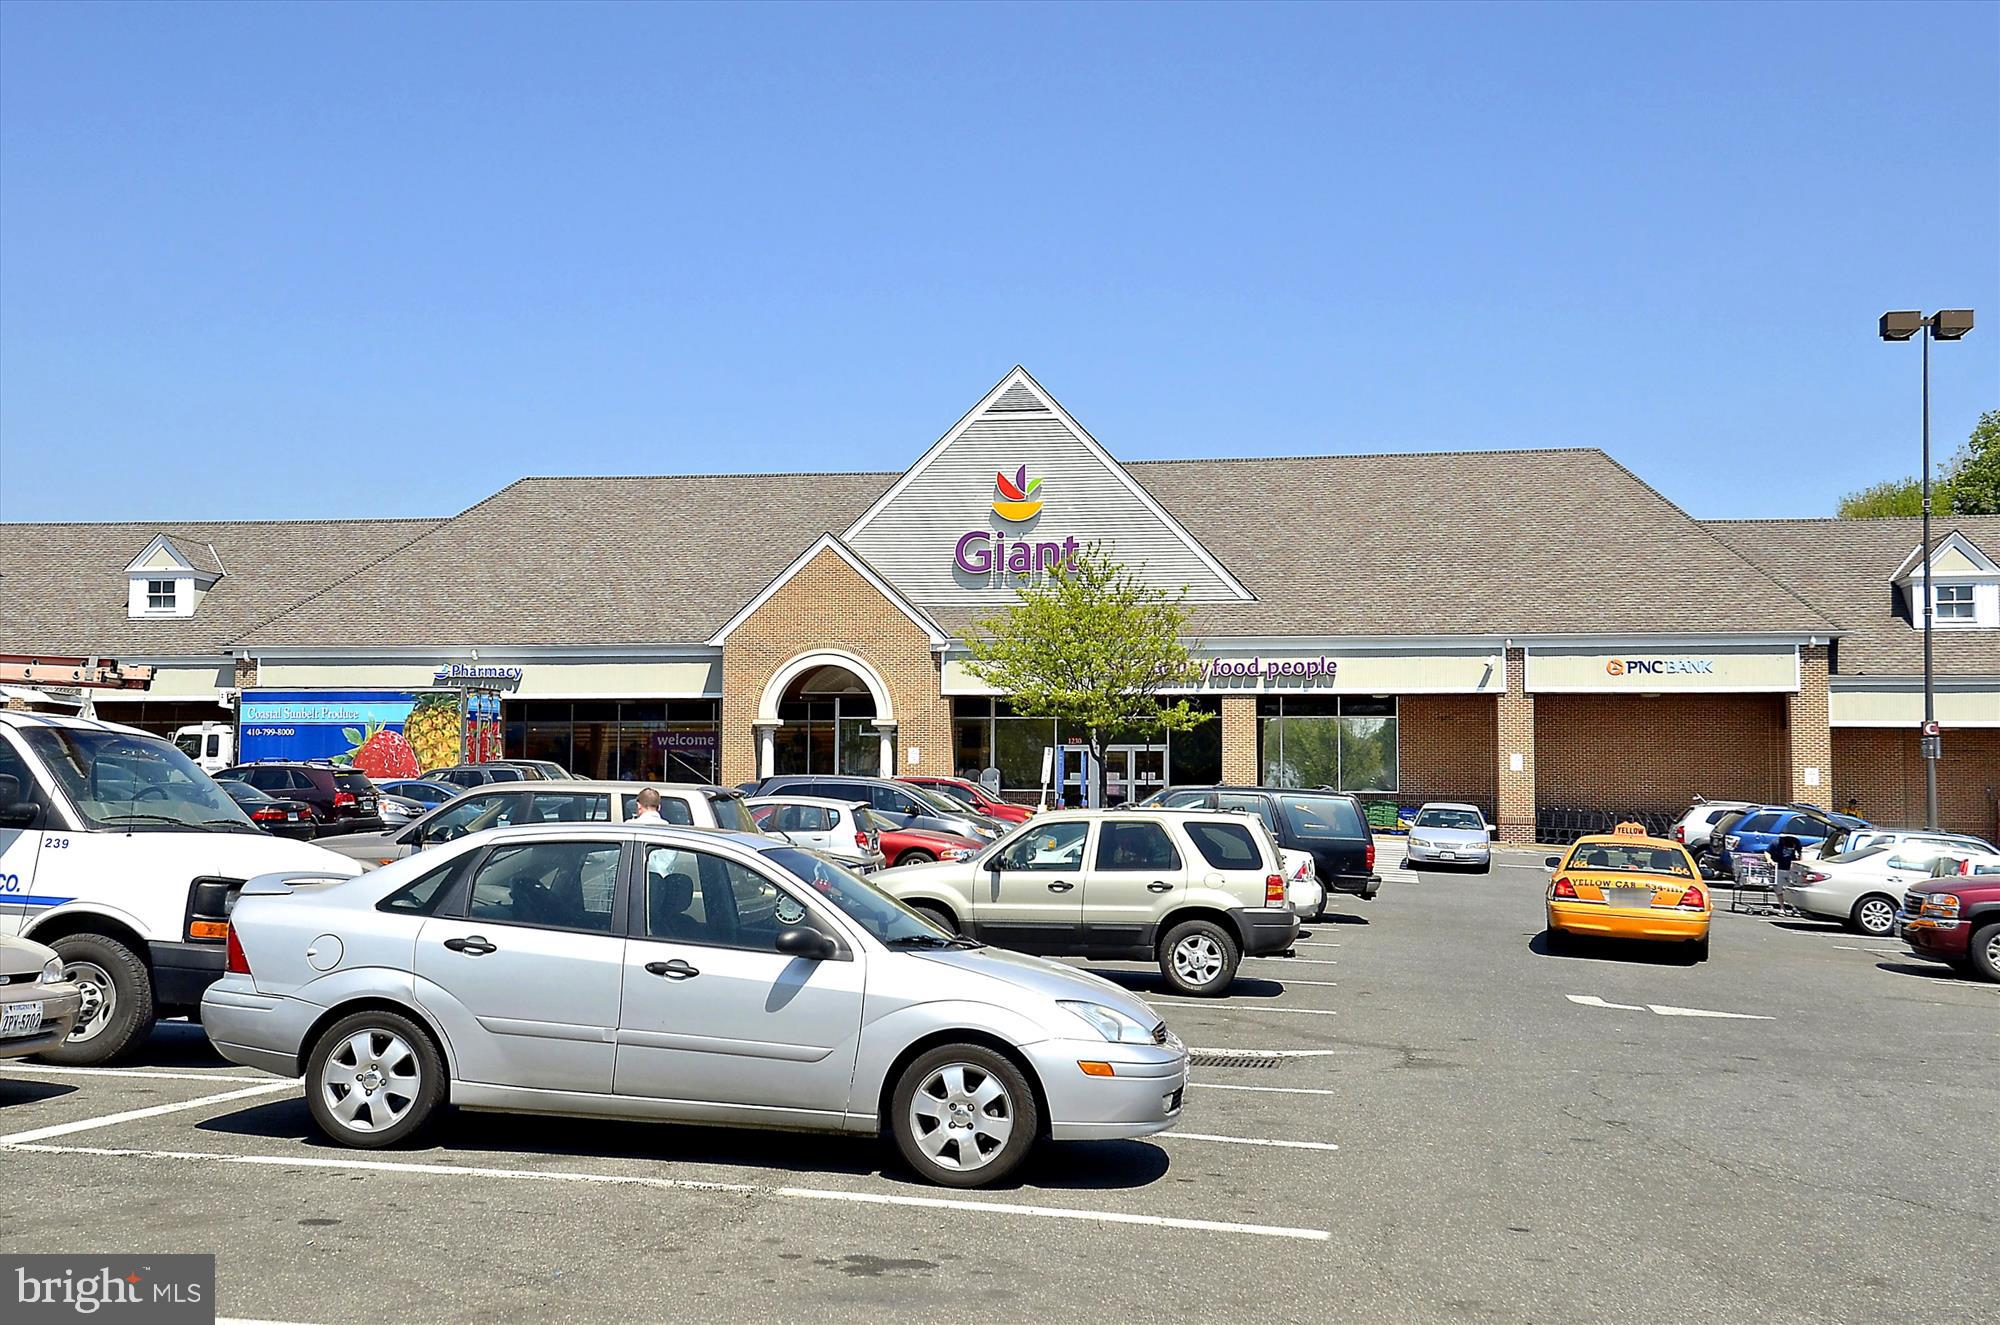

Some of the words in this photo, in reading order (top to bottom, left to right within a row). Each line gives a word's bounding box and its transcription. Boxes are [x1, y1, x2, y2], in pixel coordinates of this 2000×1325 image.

[955, 531, 1080, 573] Giant
[452, 664, 522, 681] Pharmacy
[1212, 657, 1260, 676] food
[1267, 656, 1338, 680] people
[1626, 660, 1664, 674] PNC
[1665, 660, 1714, 674] BANK
[247, 706, 282, 720] Coastal
[283, 706, 320, 720] Sunbelt
[322, 706, 360, 720] Produce
[246, 728, 295, 736] 410-799-8000
[1925, 723, 1938, 735] C
[657, 733, 714, 746] welcome
[1617, 827, 1645, 835] YELLOW
[44, 837, 70, 849] 239
[1572, 878, 1612, 887] YELLOW
[1615, 880, 1636, 888] CAB
